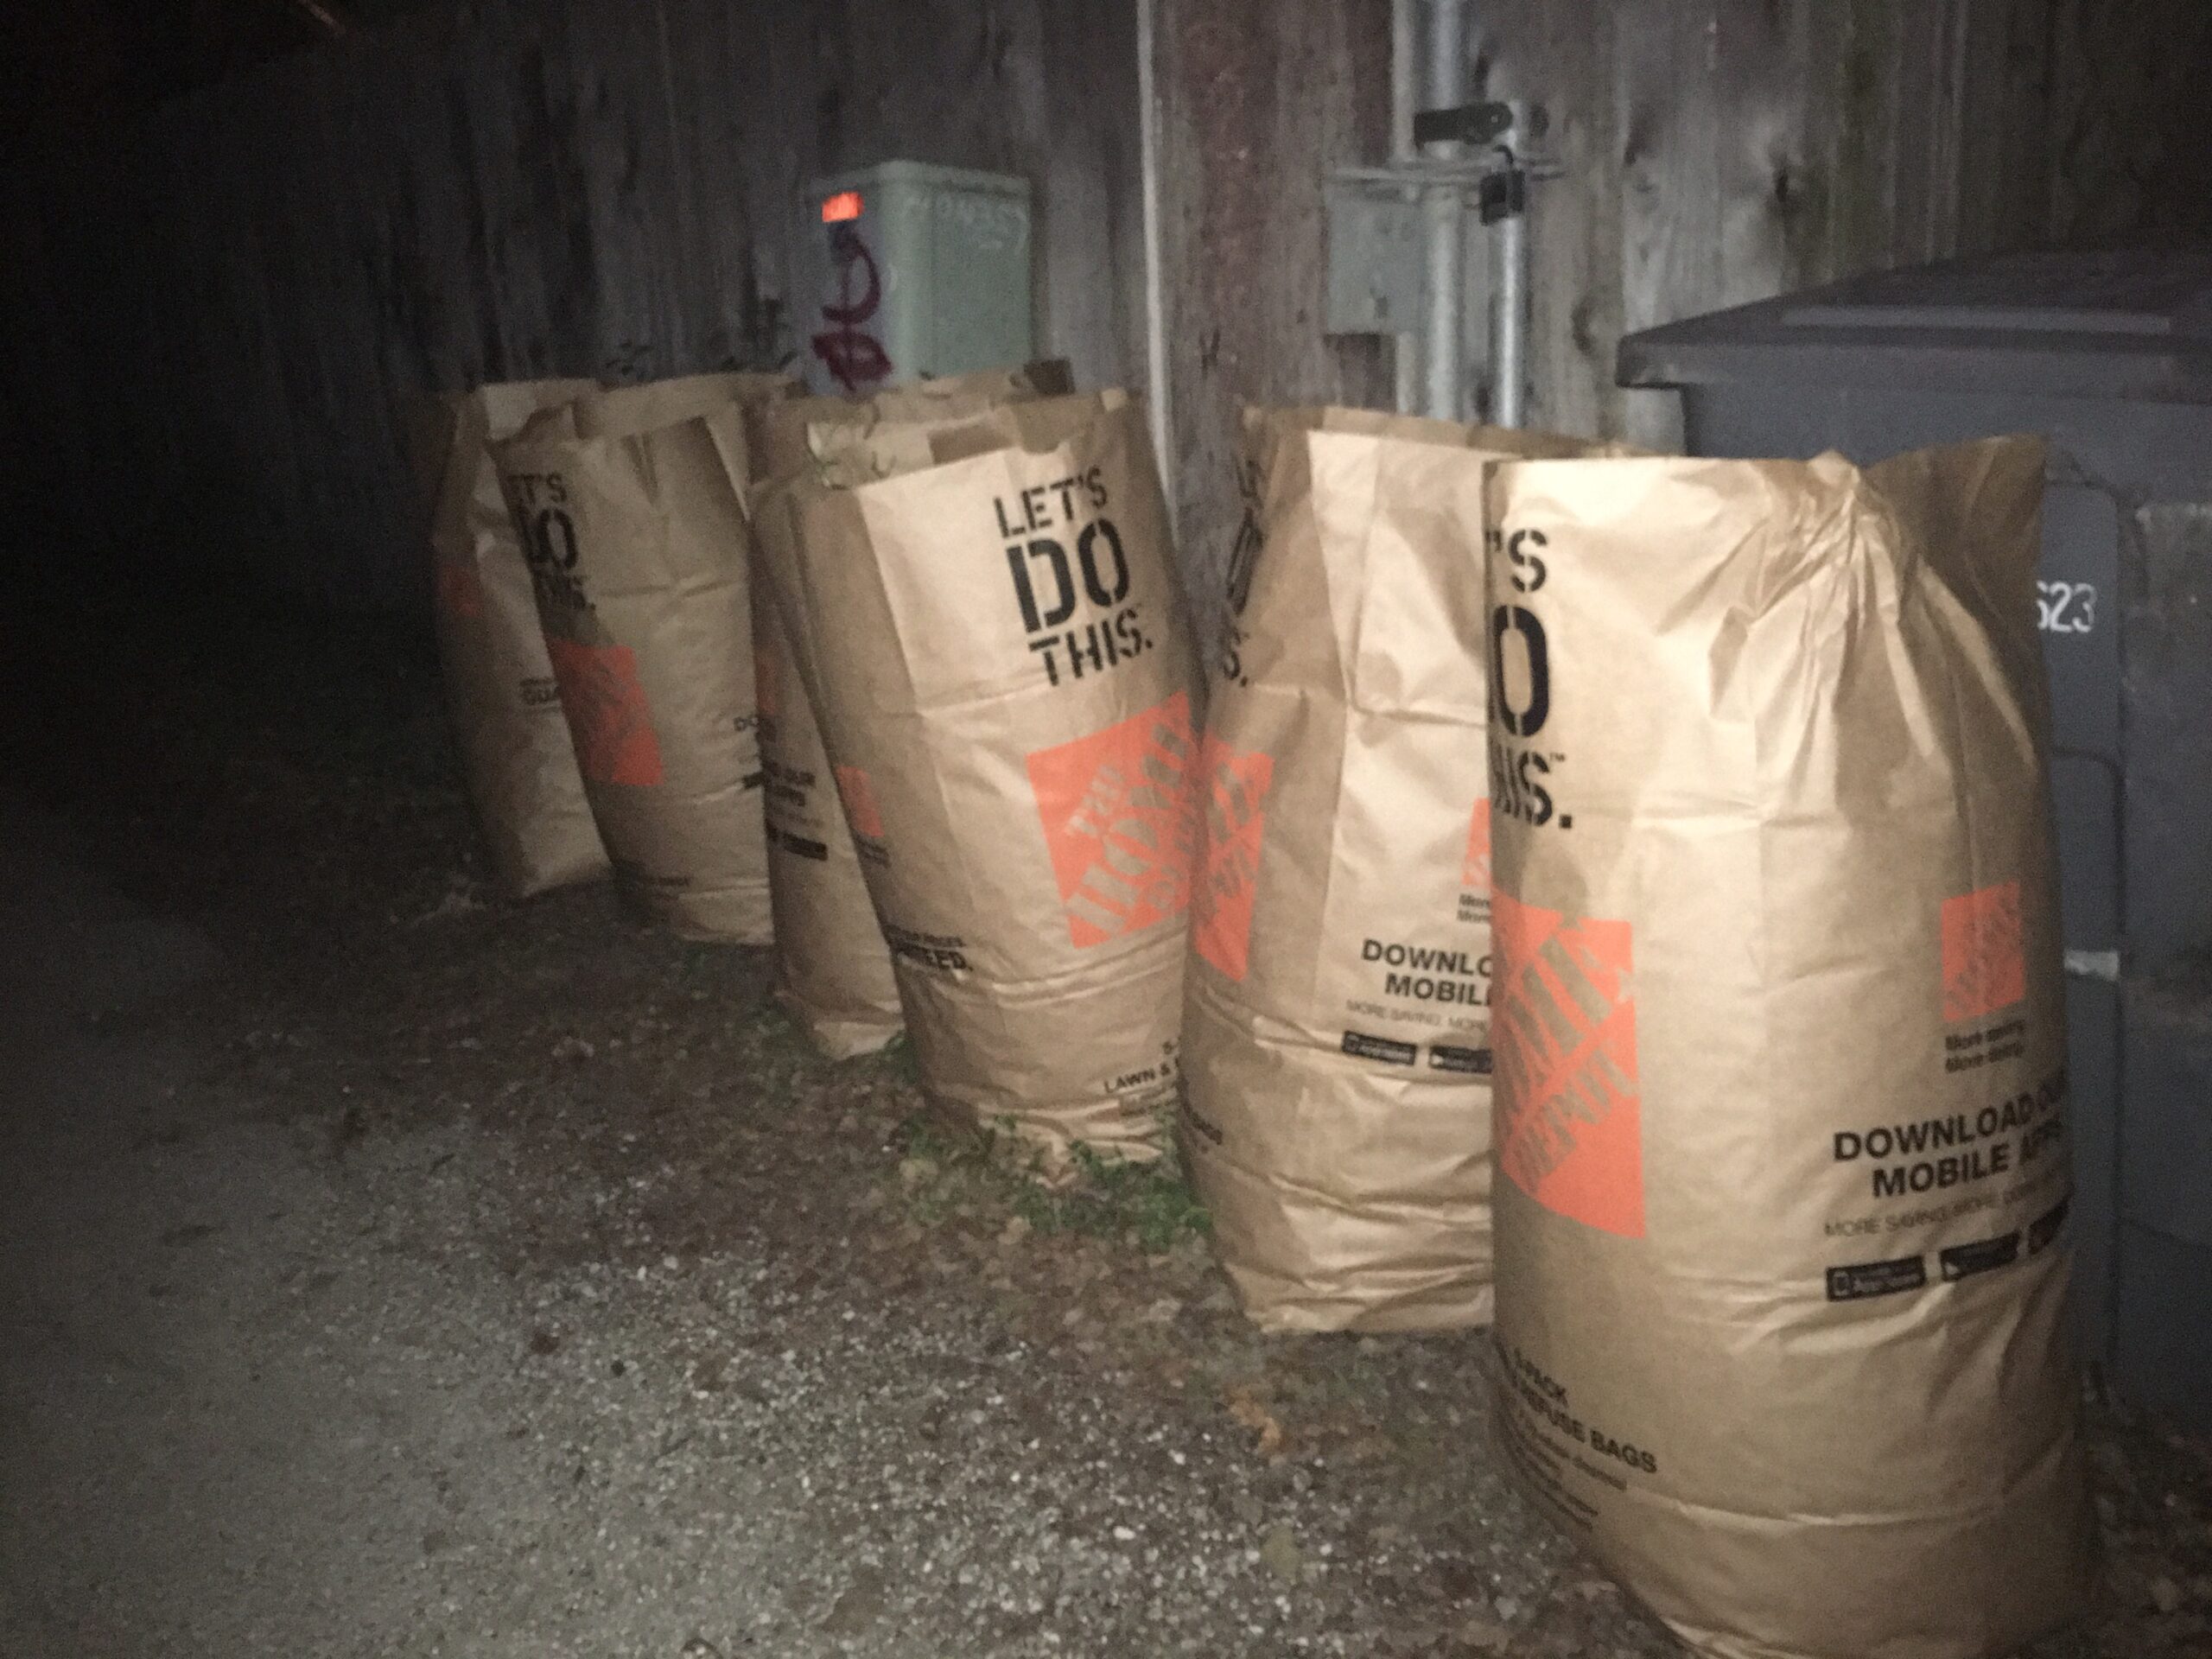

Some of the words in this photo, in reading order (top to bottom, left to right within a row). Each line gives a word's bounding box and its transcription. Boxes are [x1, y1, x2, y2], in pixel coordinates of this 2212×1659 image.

[994, 464, 1108, 538] LET'S
[1006, 518, 1130, 633] DO
[1028, 607, 1154, 687] THIS.
[1490, 605, 1550, 738] O
[1361, 938, 1493, 979] DOWNLO
[1384, 973, 1493, 1007] MOBIL
[1833, 1091, 2036, 1162] DOWNLOAD
[1872, 1141, 2011, 1198] MOBILE
[1590, 1428, 1658, 1474] BAGS
